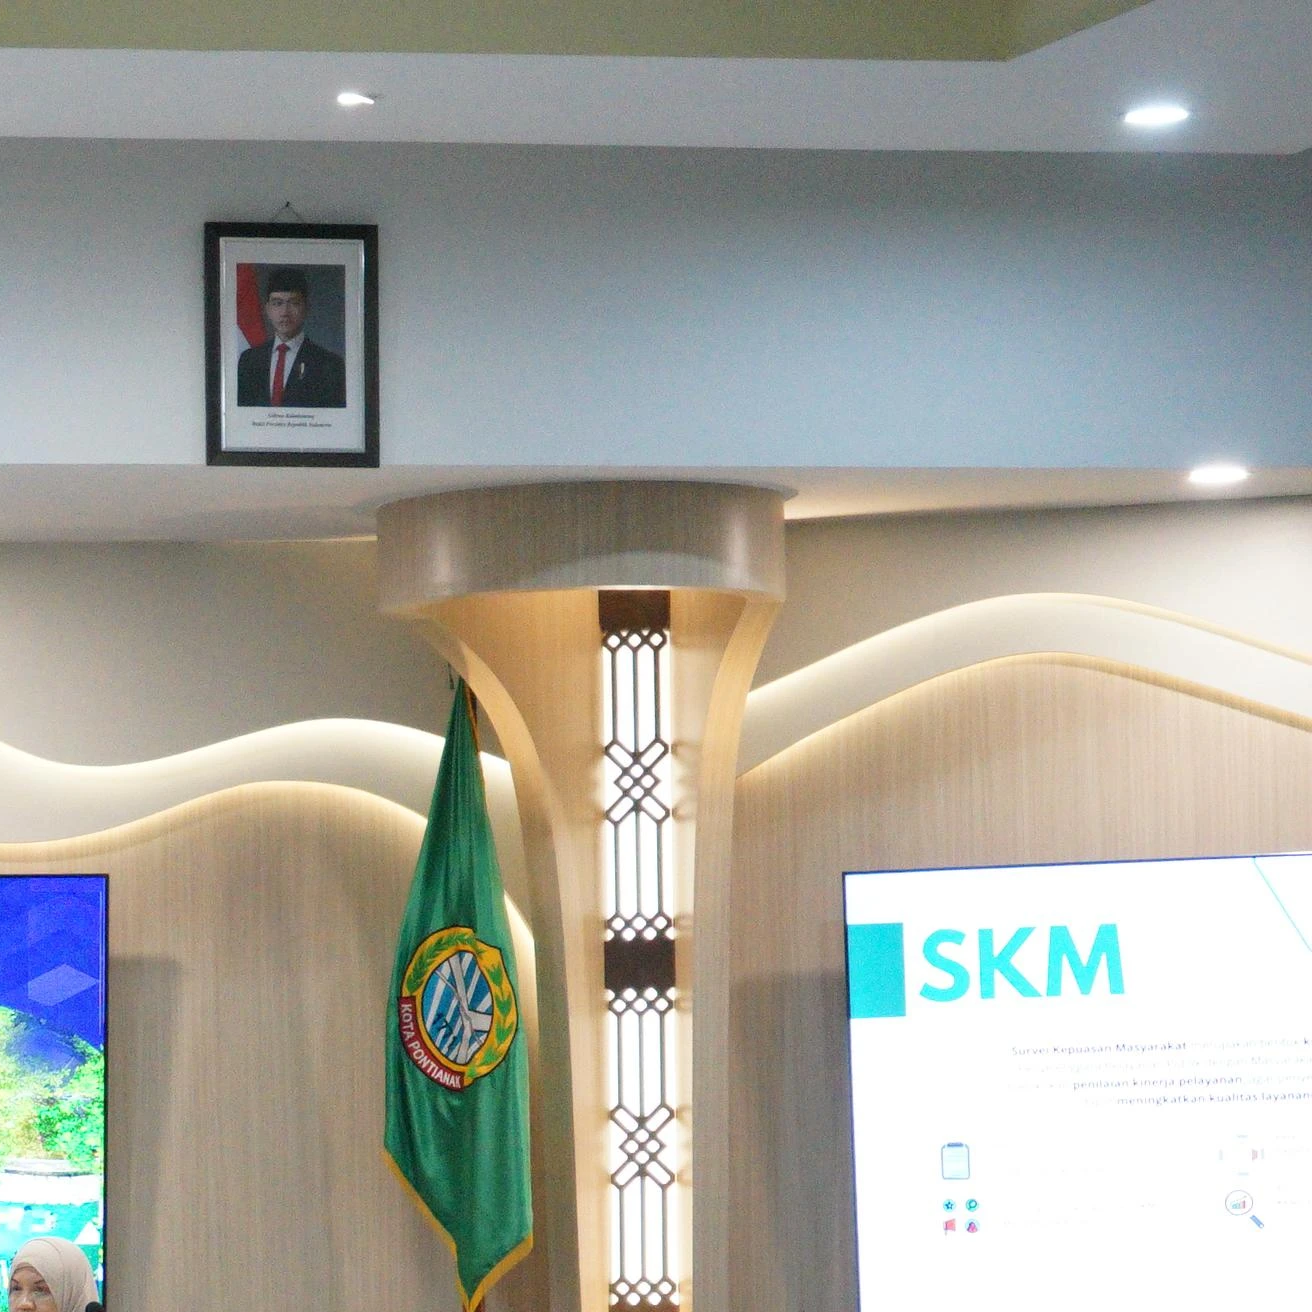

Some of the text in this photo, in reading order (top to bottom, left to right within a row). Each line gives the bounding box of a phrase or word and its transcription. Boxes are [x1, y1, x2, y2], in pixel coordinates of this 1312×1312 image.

[919, 923, 1125, 1002] SKM
[401, 1003, 462, 1089] KOTA PONTIANAK
[1053, 1044, 1112, 1055] Kepuasan
[1116, 1041, 1186, 1053] Masyarakat
[1133, 1078, 1175, 1089] kinerja
[1117, 1094, 1205, 1106] meningkatkan
[1209, 1093, 1257, 1103] kualitas
